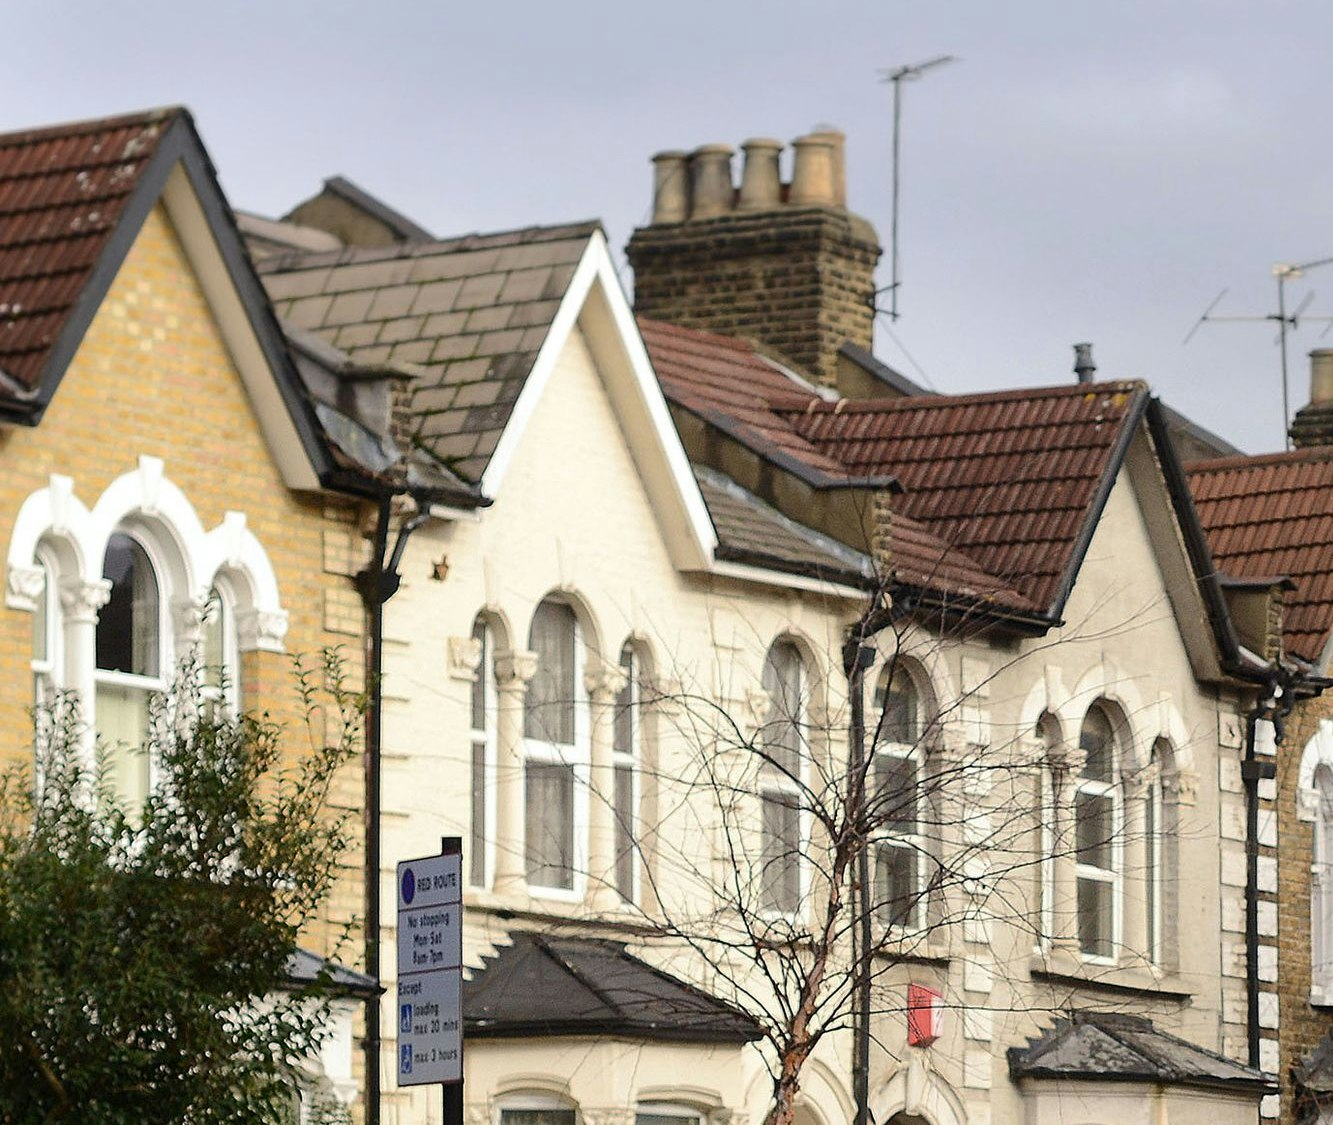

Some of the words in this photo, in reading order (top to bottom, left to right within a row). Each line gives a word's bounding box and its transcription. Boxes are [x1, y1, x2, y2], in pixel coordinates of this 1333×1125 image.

[417, 876, 431, 891] RED
[433, 872, 456, 889] ROUTE
[407, 915, 418, 928] No
[420, 912, 449, 929] stopping
[399, 981, 422, 996] Except
[414, 1002, 439, 1017] loading
[414, 1023, 429, 1036] max
[431, 1019, 440, 1034] 20
[442, 1018, 458, 1031] mins
[414, 1052, 429, 1063] max
[439, 1047, 458, 1061] hours
